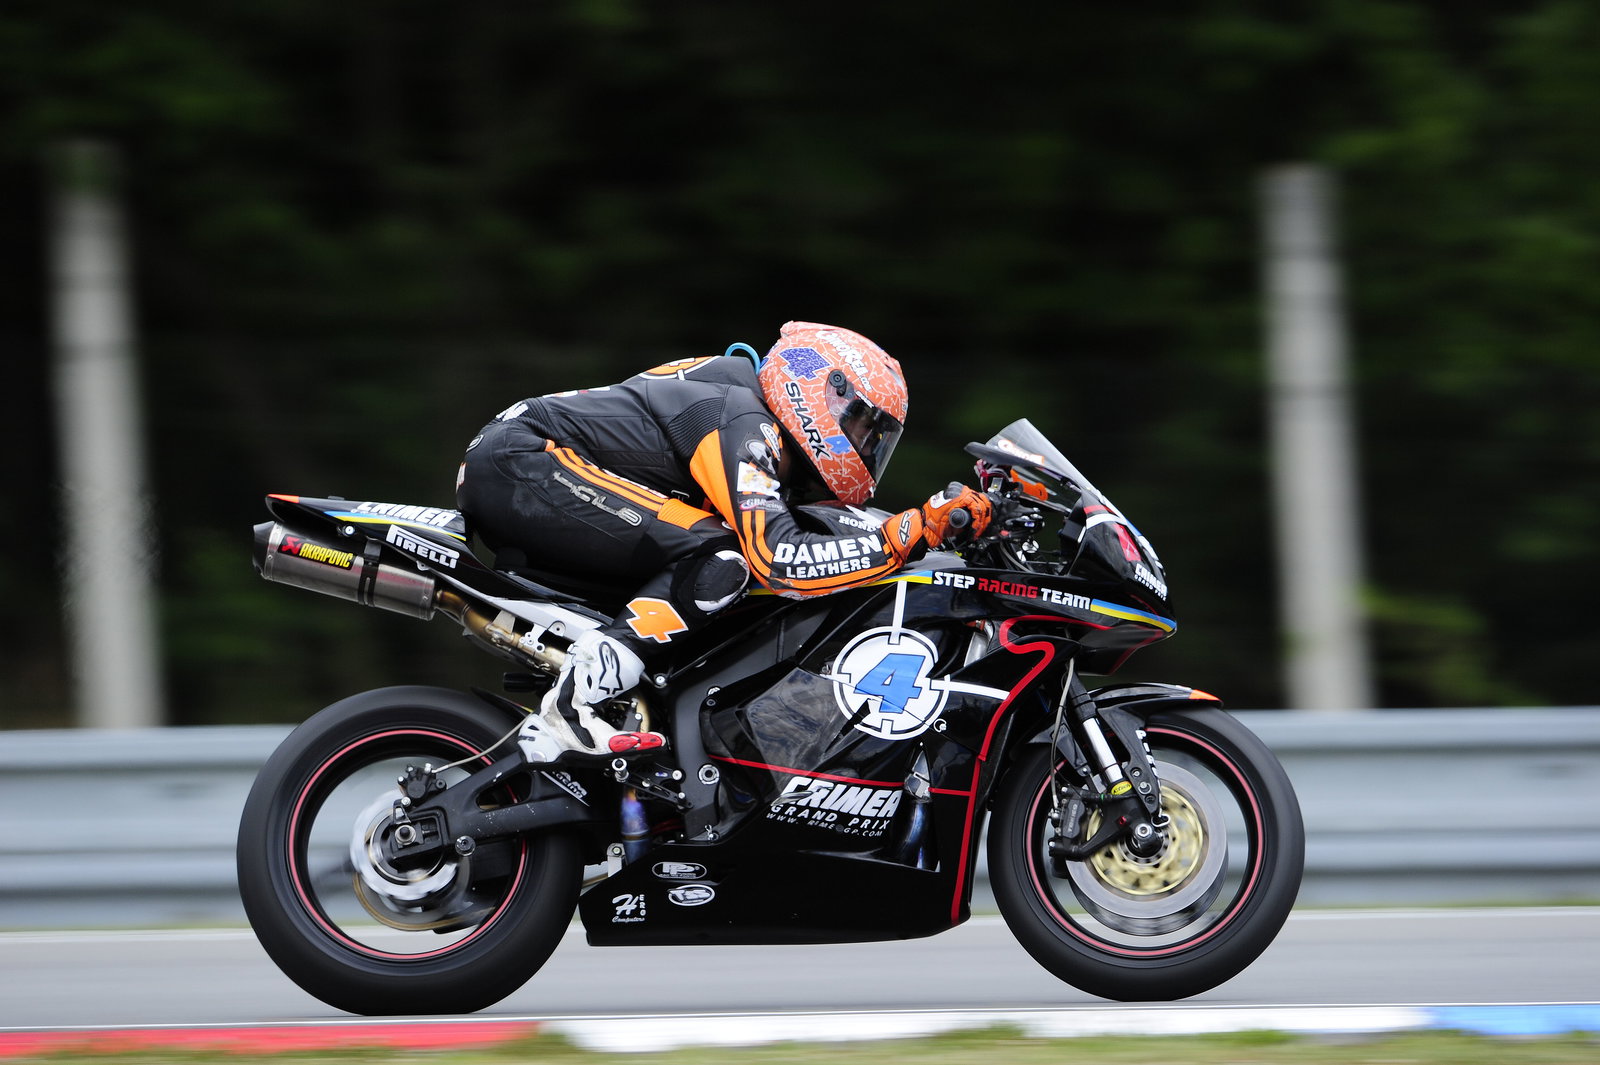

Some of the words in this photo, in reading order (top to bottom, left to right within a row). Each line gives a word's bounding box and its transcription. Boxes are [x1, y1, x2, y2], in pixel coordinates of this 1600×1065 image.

[784, 380, 833, 460] SHARK
[385, 523, 460, 569] PIRELLI
[772, 534, 883, 565] DAMEN
[786, 556, 872, 579] LEATHERS
[933, 571, 975, 589] STEP
[978, 577, 1039, 599] RACING
[1041, 587, 1091, 610] TEAM
[626, 597, 689, 644] 4
[853, 652, 926, 715] 4
[770, 804, 839, 823] GRAND
[847, 817, 891, 831] PRIX
